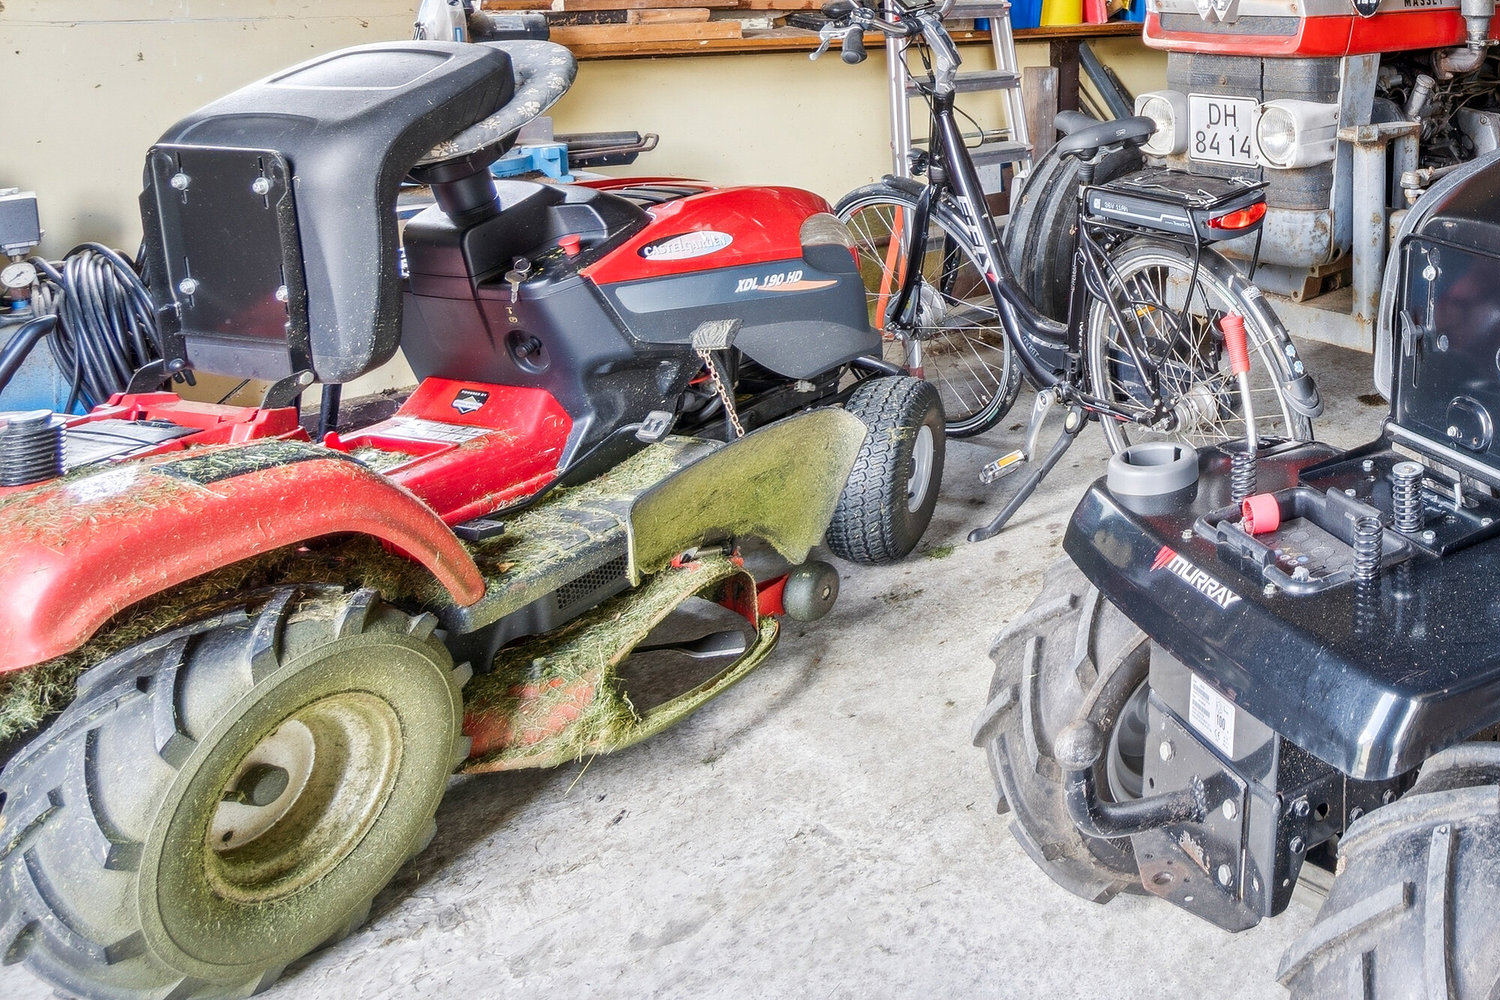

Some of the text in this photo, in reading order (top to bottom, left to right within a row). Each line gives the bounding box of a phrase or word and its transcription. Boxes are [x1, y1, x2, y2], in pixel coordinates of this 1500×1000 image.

[1208, 103, 1237, 127] DH
[1195, 131, 1251, 159] 84 14
[735, 270, 802, 293] XDL 190 HD
[1167, 554, 1243, 610] MURRAY
